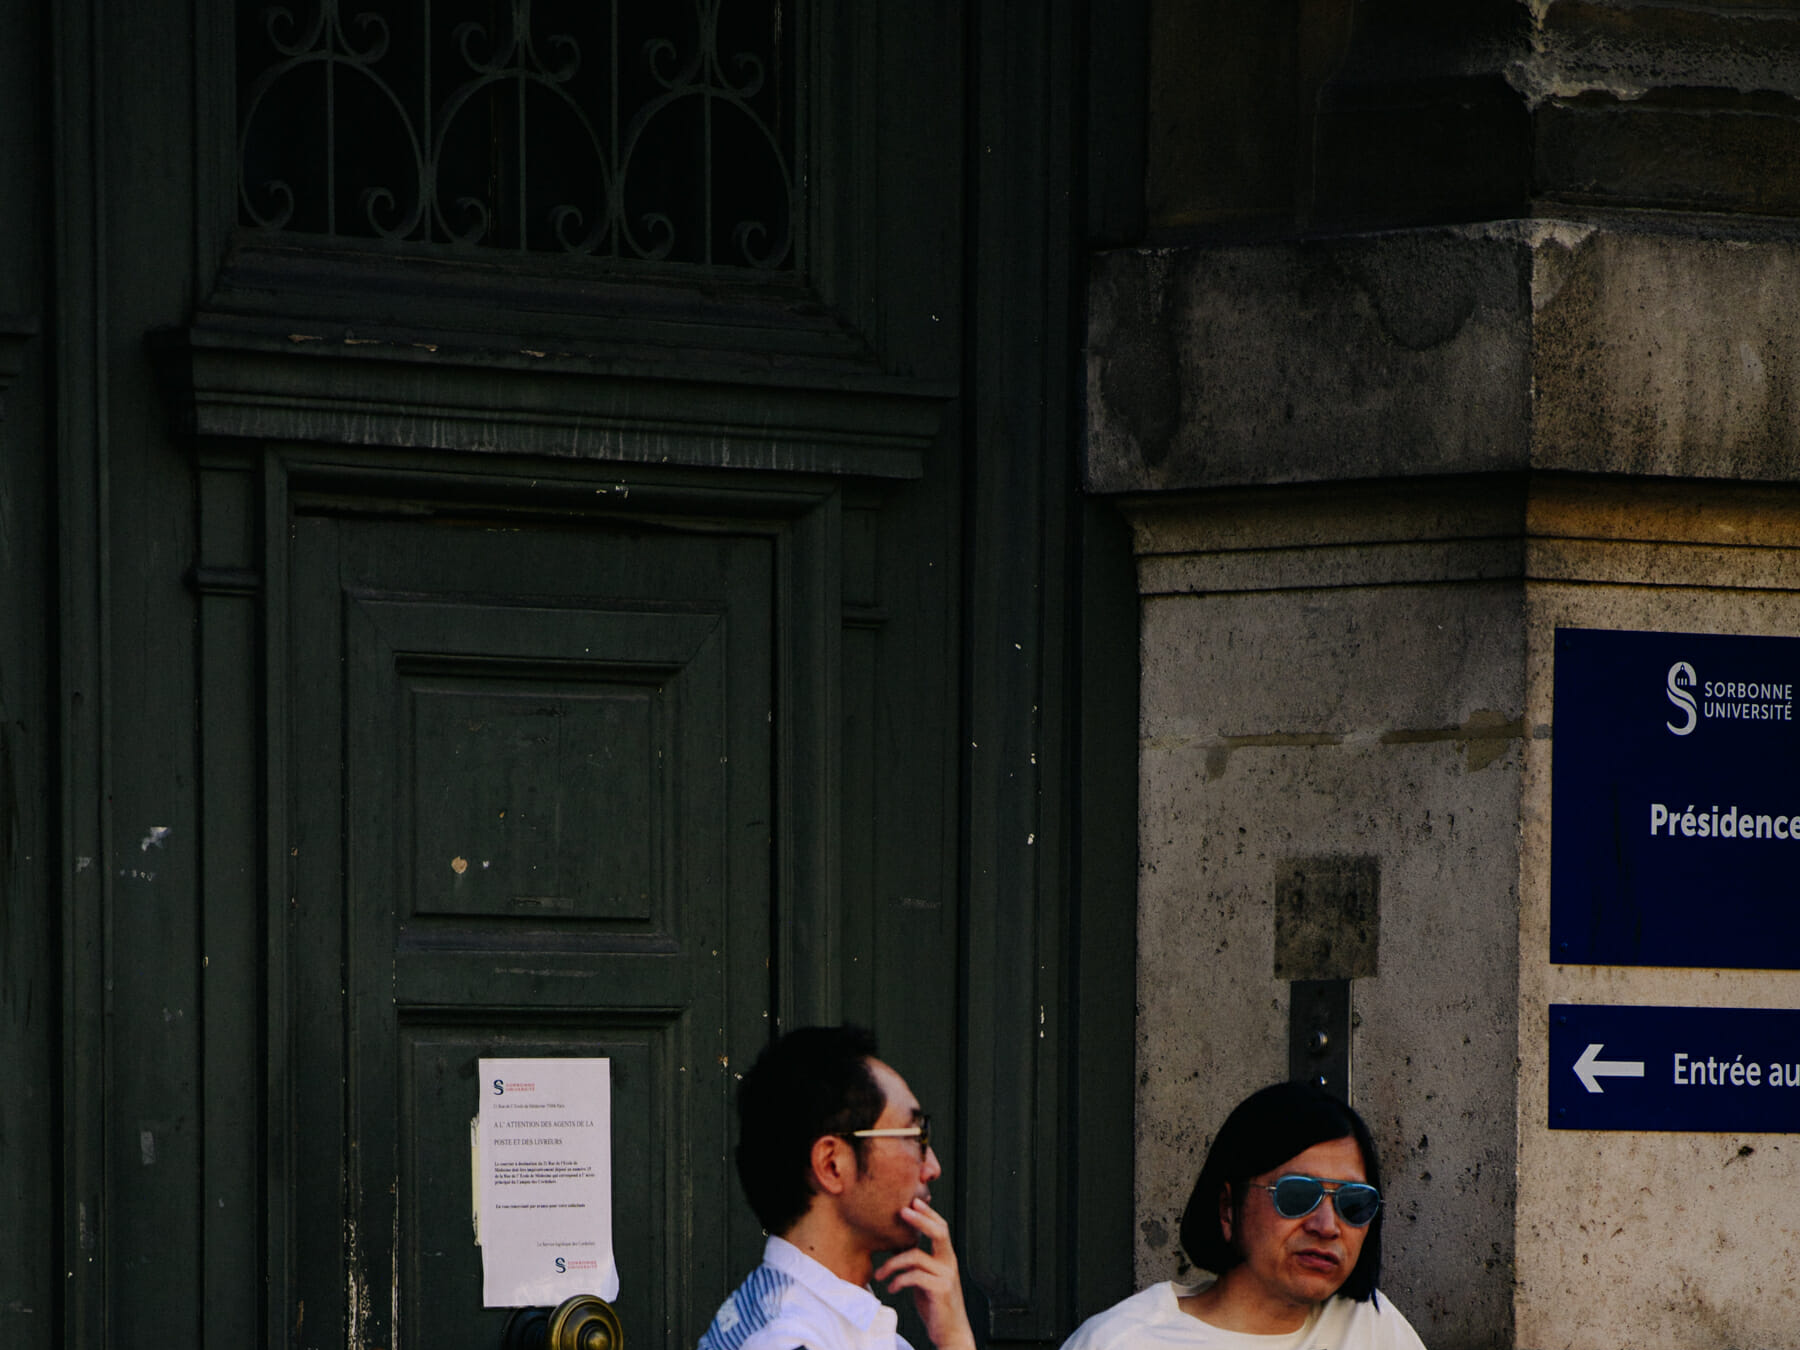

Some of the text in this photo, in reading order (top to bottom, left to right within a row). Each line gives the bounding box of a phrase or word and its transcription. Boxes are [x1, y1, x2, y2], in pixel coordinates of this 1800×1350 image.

[1704, 681, 1793, 700] SORBONNE
[1704, 700, 1793, 721] UNIVERSITÉ
[1650, 803, 1800, 840] Présidence
[1674, 1053, 1761, 1086] Entrée
[507, 1120, 540, 1128] ATTENTION
[541, 1120, 552, 1128] DES
[553, 1120, 576, 1128] AGENTS
[494, 1139, 512, 1147] POSTE
